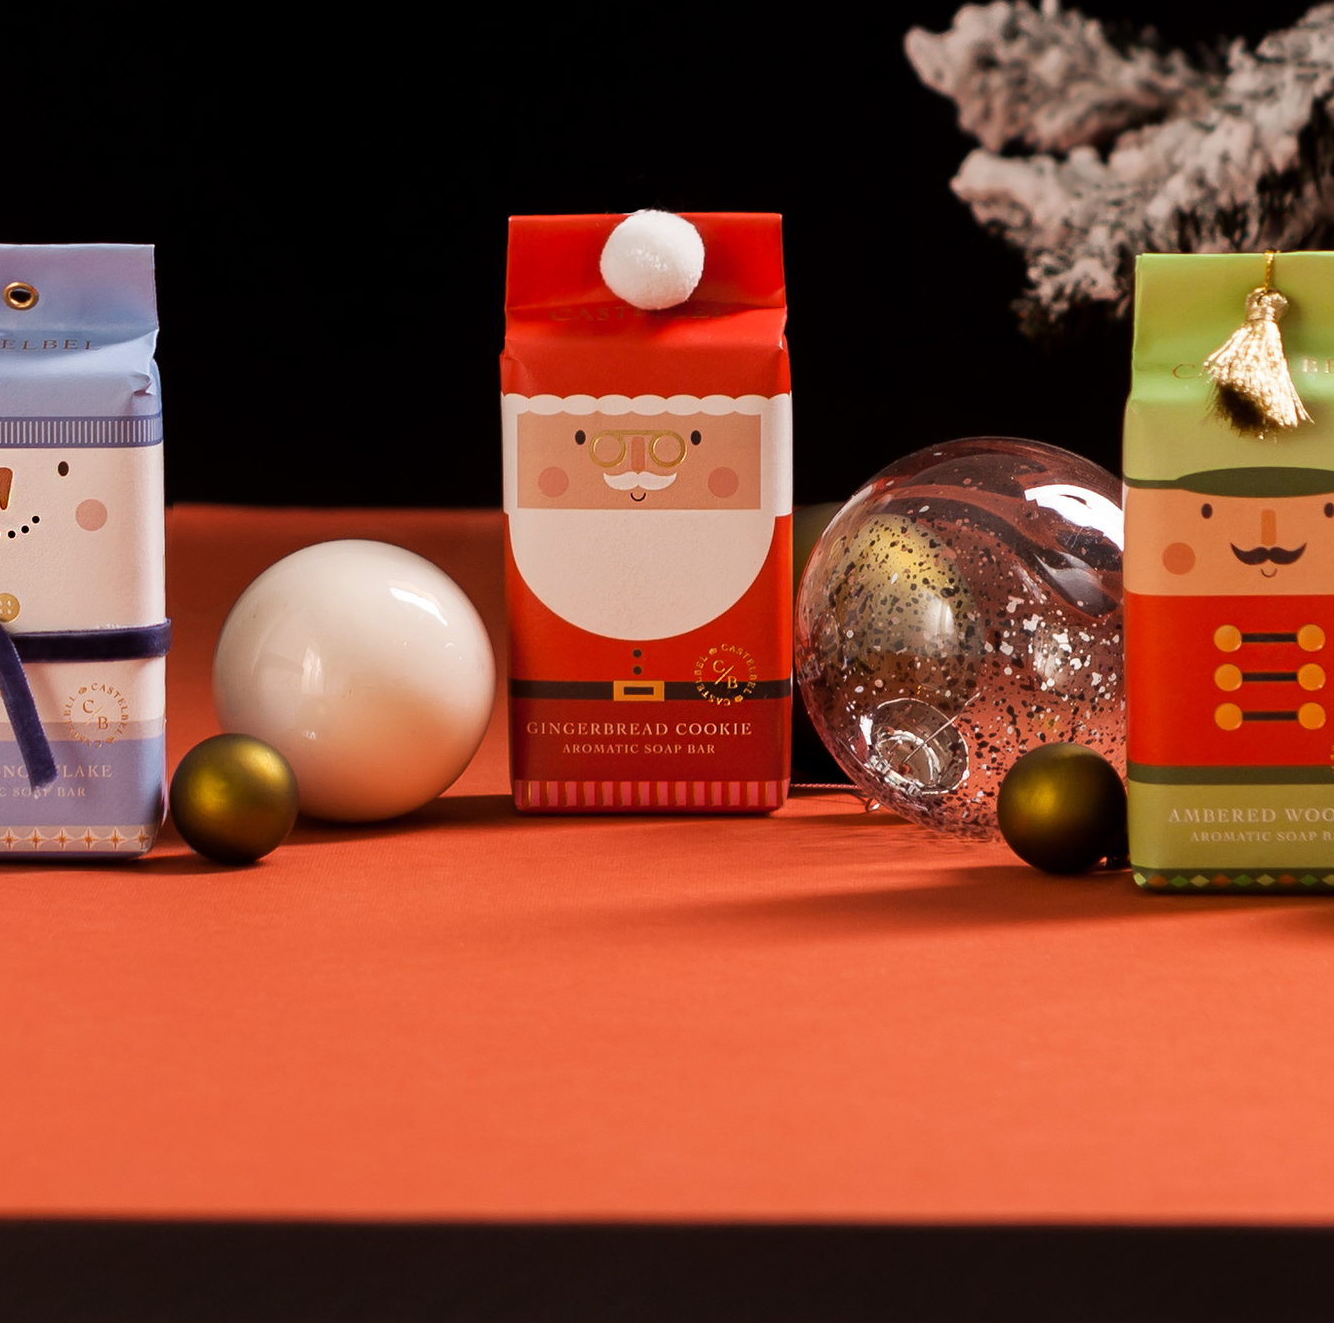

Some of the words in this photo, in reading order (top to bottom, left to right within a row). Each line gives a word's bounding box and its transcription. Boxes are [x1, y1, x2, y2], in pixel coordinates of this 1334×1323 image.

[527, 722, 668, 735] GINGERBREAD
[675, 722, 752, 735] COOKIE
[562, 744, 640, 754] AROMATIC
[644, 744, 682, 754] SOAP
[687, 744, 715, 754] BAR
[57, 787, 86, 797] BAR
[1168, 808, 1277, 823] AMBERED
[1190, 831, 1271, 842] AROMATIC
[1276, 830, 1317, 841] SOAP
